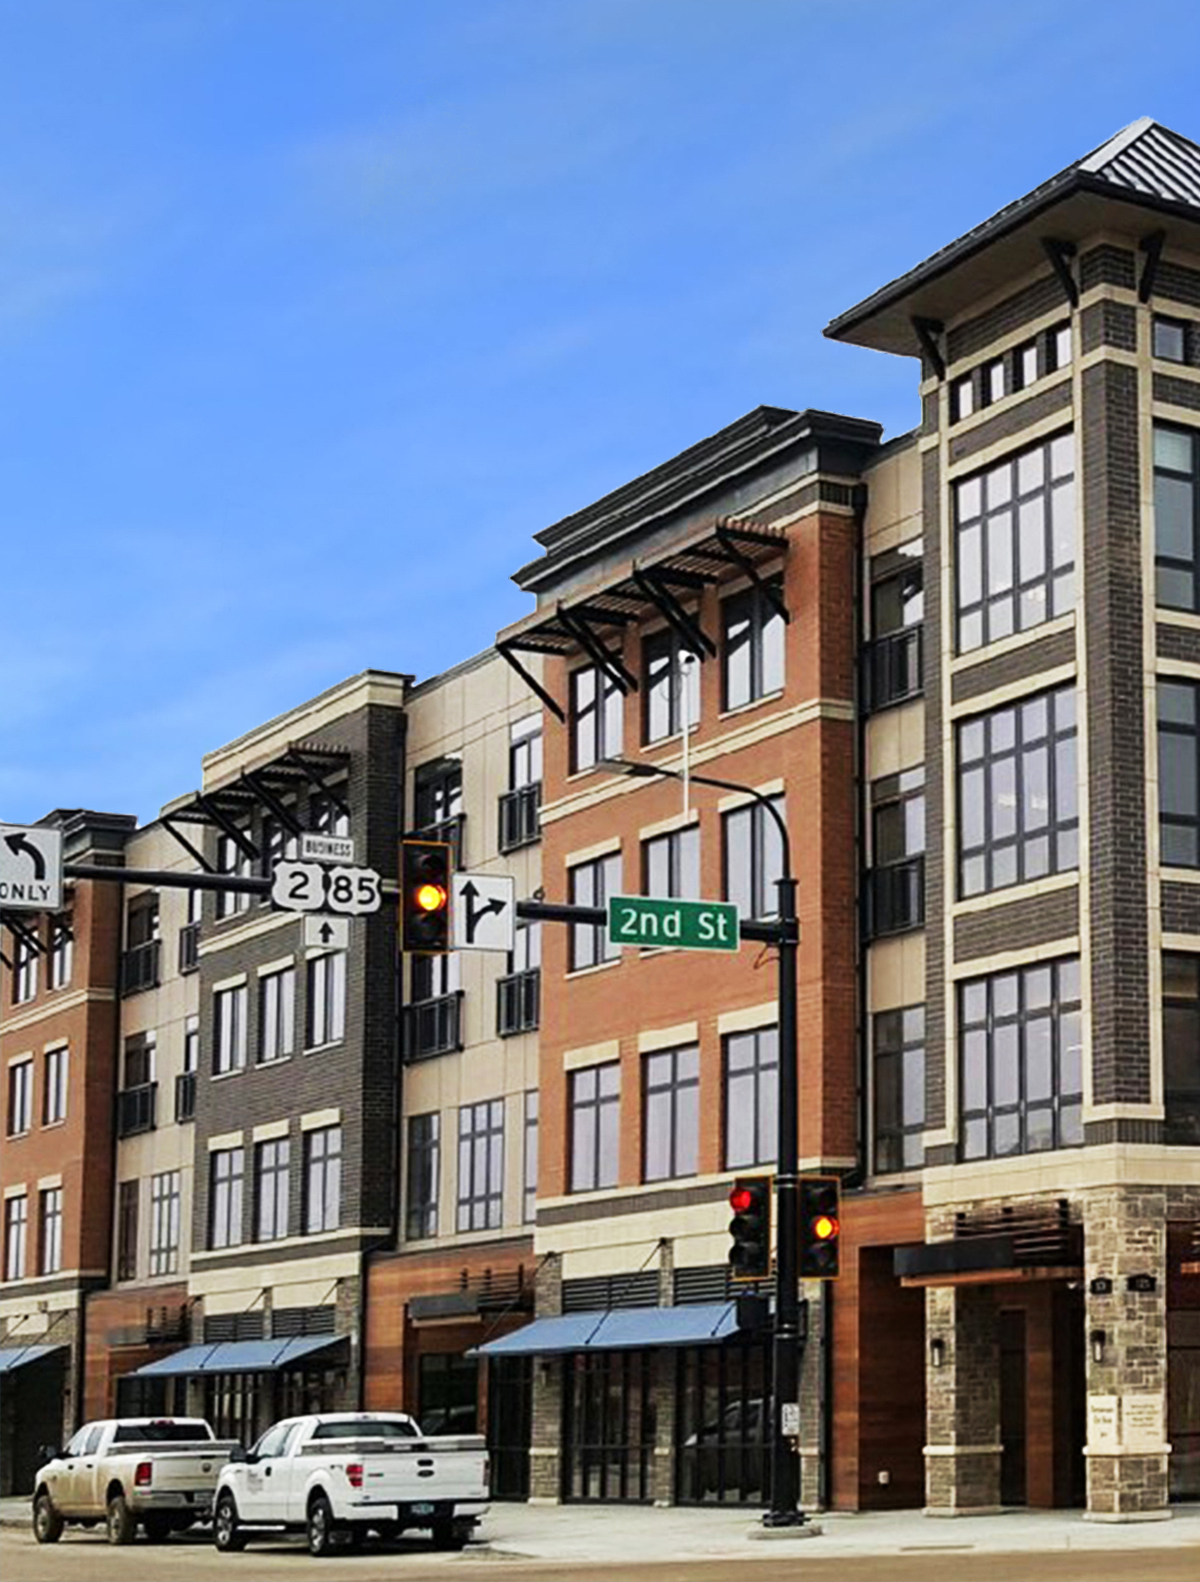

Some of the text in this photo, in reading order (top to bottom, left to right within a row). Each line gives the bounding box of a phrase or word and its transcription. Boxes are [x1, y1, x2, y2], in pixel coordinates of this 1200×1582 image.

[306, 840, 351, 857] BUSINESS
[0, 882, 51, 901] ONLY
[288, 871, 310, 900] 2
[333, 875, 376, 905] 85
[620, 908, 728, 941] 2nd St
